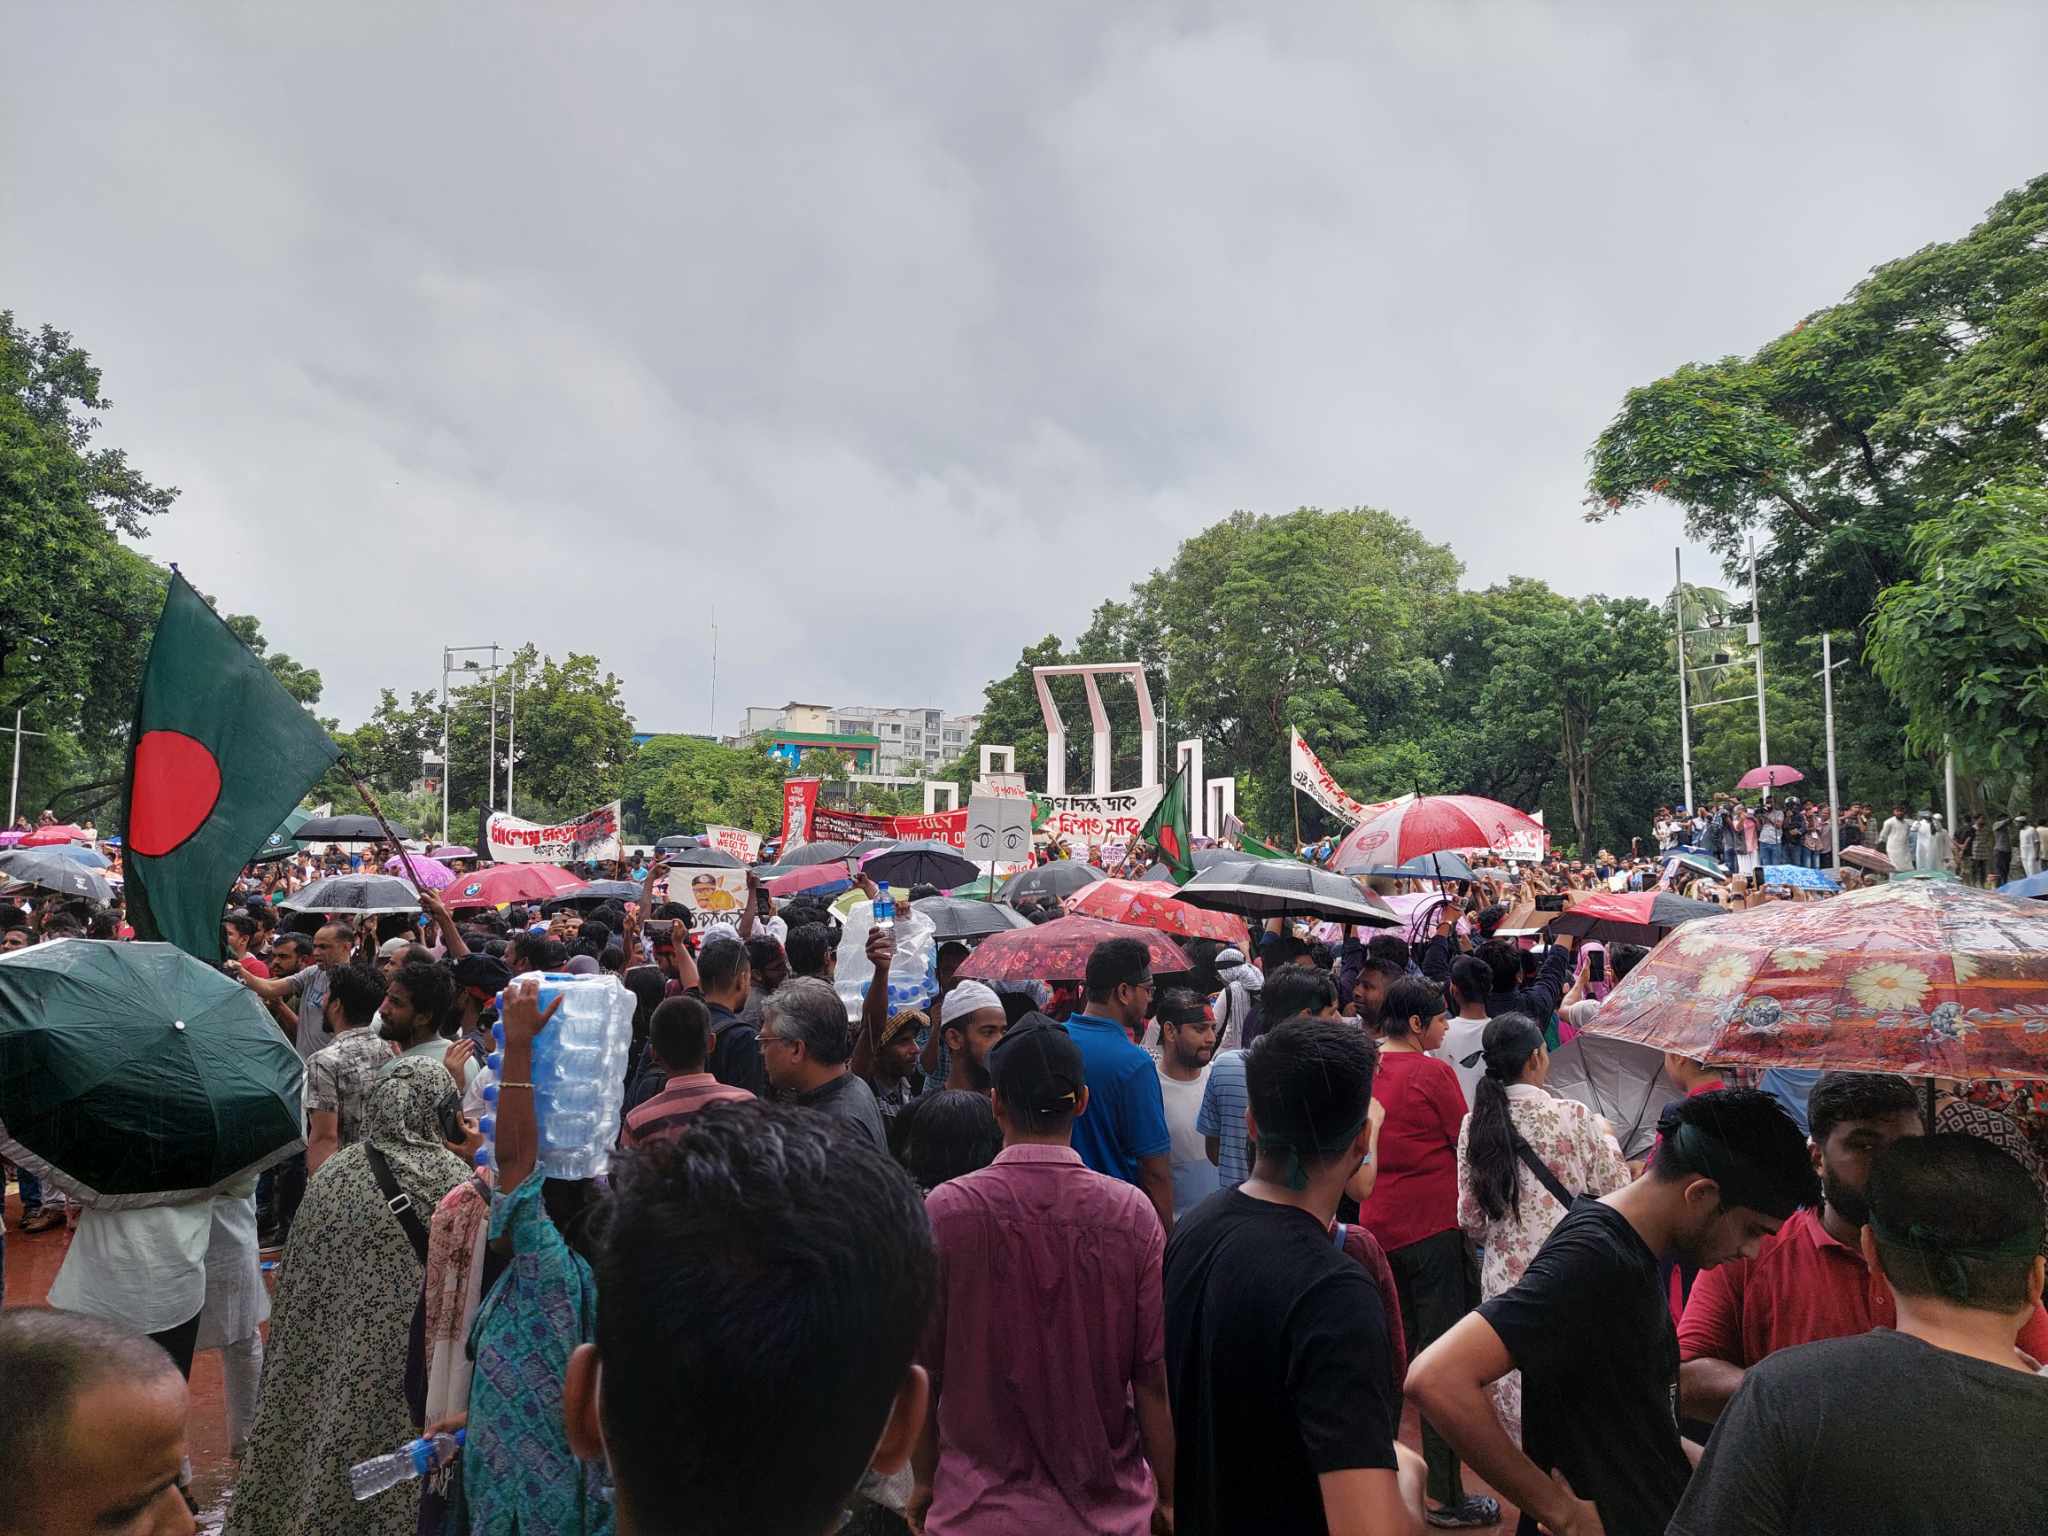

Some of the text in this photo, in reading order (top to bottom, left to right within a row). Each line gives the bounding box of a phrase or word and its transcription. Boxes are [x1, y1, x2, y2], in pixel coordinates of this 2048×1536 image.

[917, 817, 952, 829] JULY
[1060, 813, 1103, 836] নিপাত
[719, 831, 747, 843] WHO DO
[932, 832, 948, 844] GO
[717, 839, 728, 848] WE
[740, 843, 749, 851] TO
